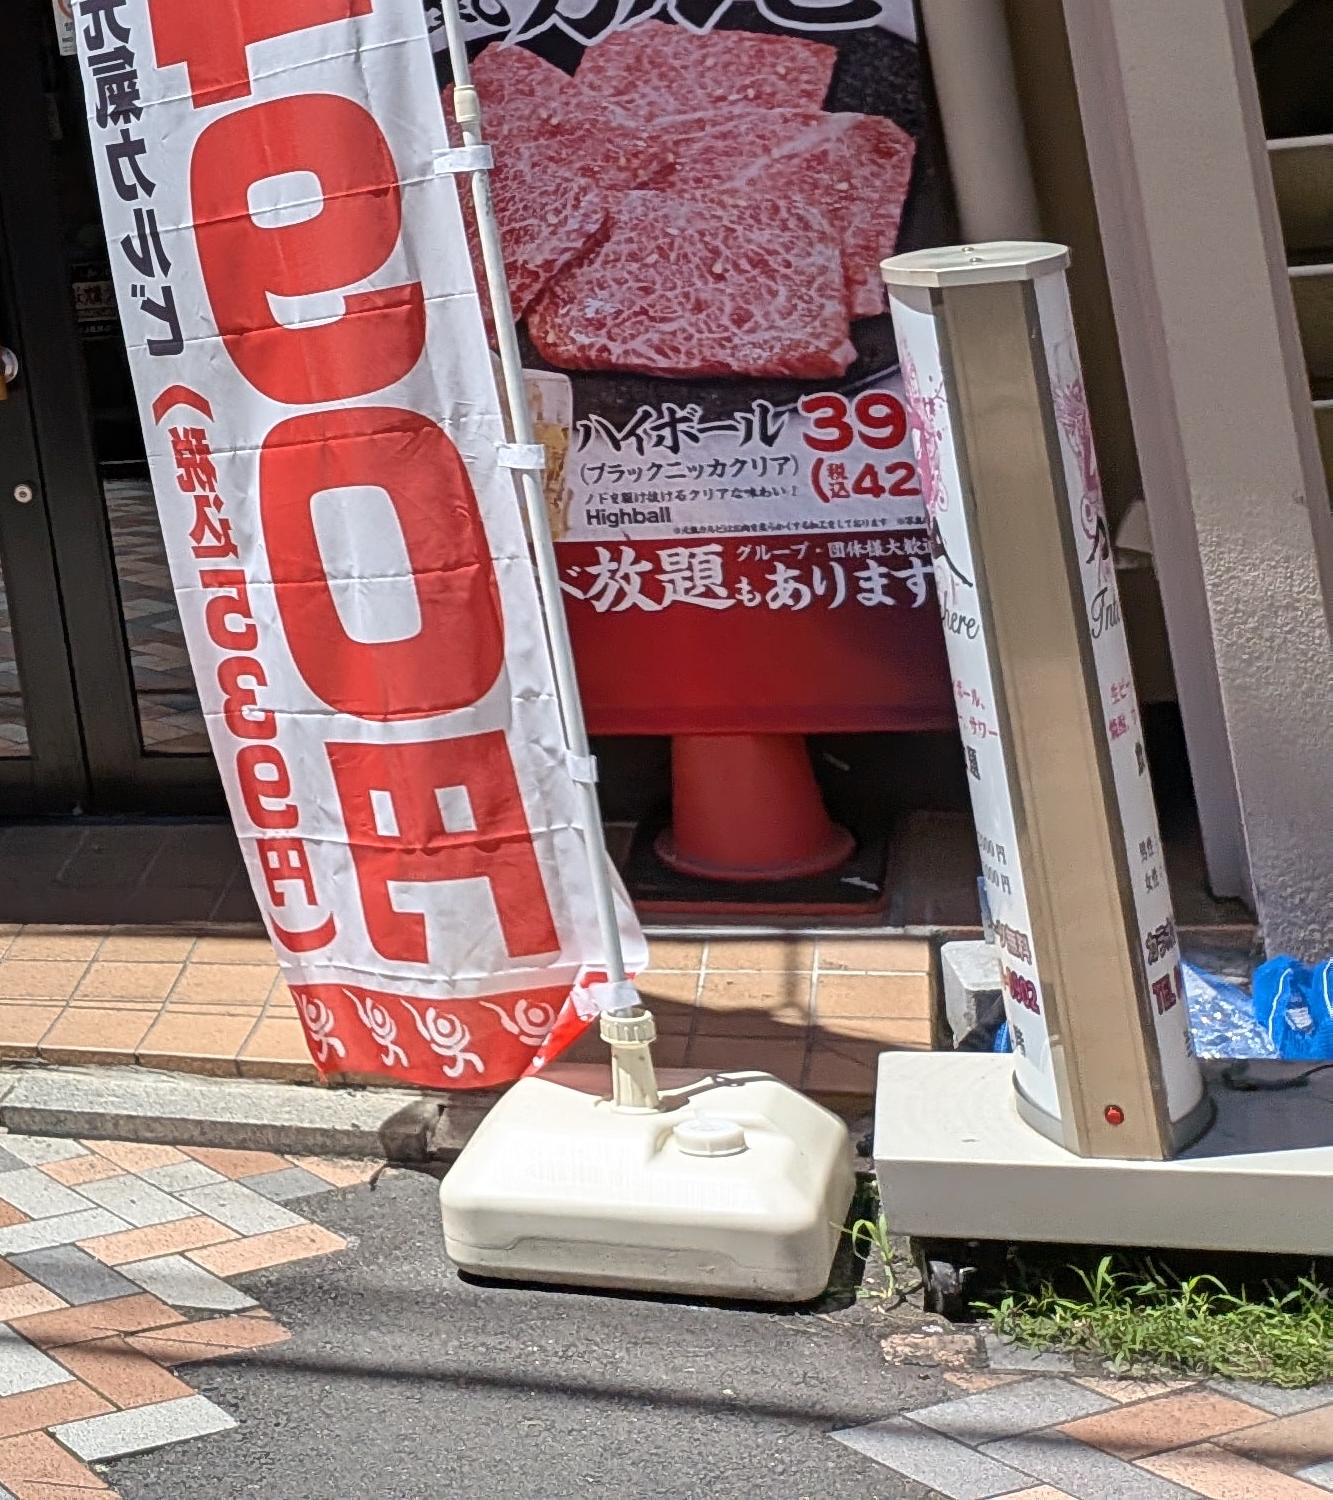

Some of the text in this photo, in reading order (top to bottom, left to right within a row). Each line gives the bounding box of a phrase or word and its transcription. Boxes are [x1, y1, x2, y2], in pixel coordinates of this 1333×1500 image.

[578, 400, 790, 456] ハイボール
[585, 506, 672, 528] Highball
